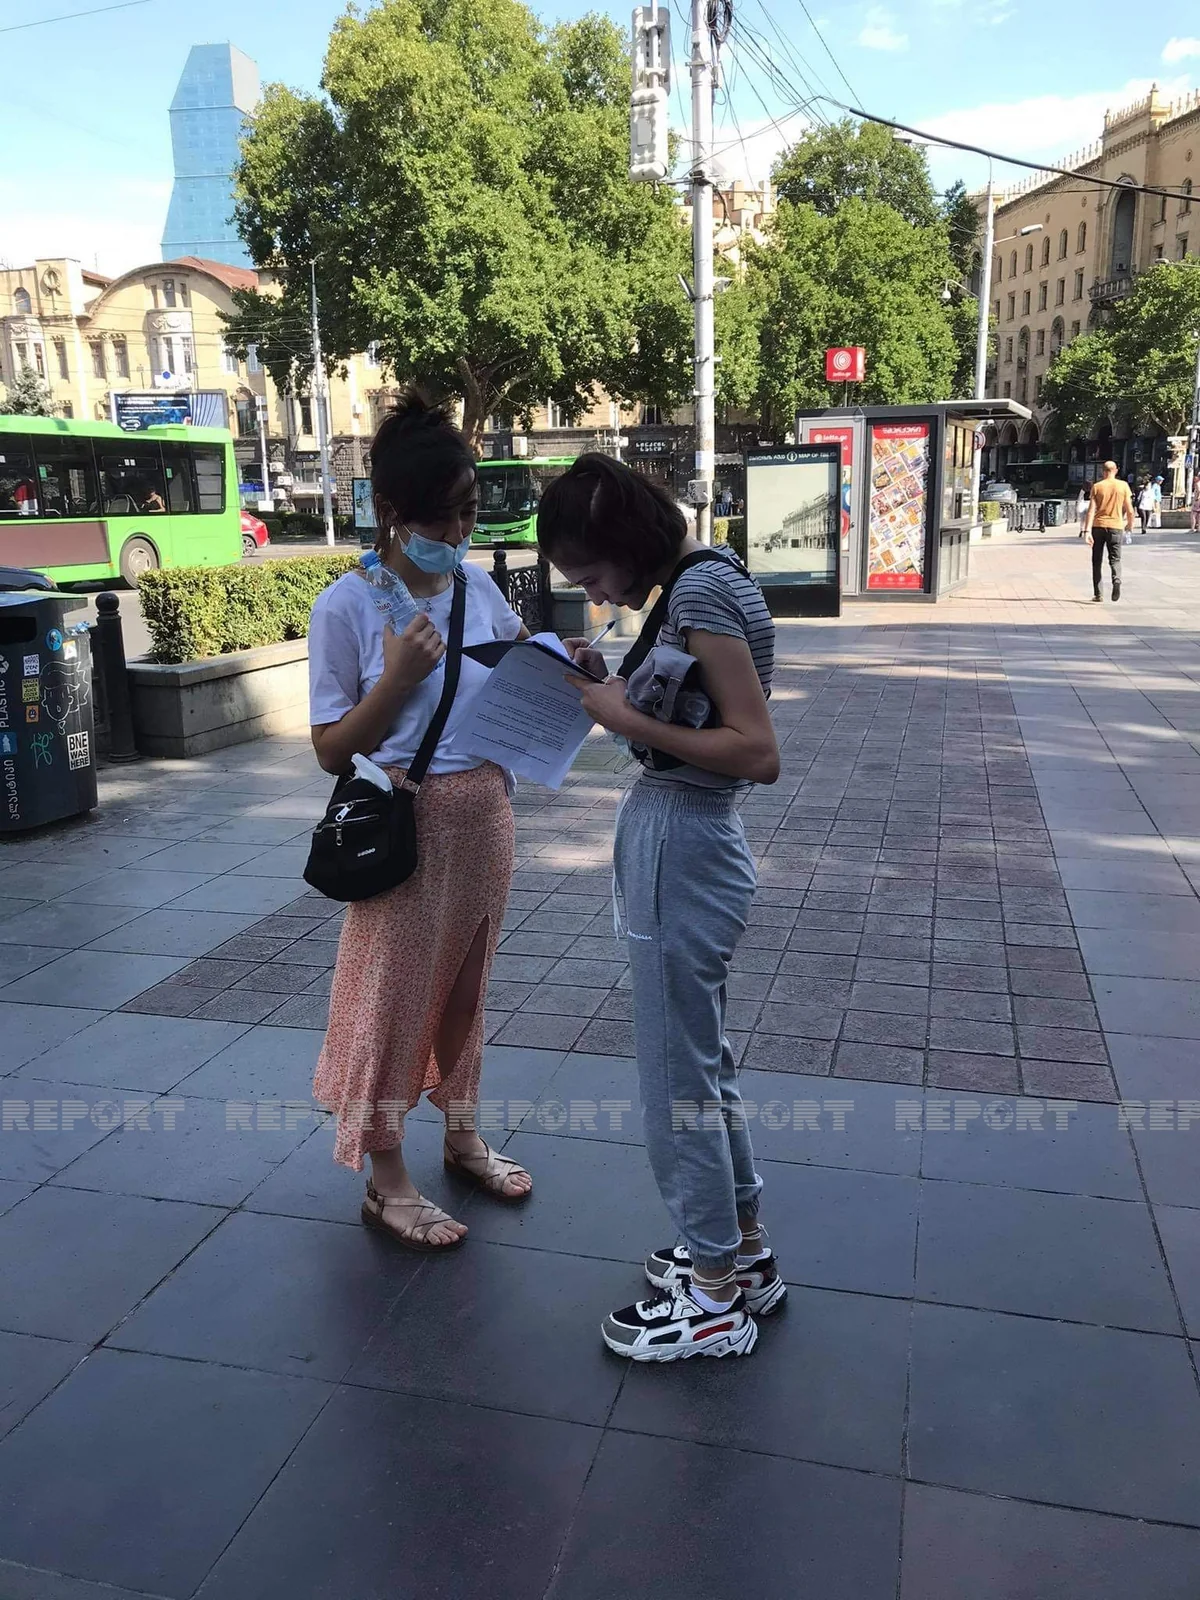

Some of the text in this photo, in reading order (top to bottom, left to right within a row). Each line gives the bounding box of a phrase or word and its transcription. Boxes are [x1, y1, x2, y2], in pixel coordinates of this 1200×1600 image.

[69, 733, 88, 751] BNE
[70, 748, 88, 760] WAS
[70, 756, 89, 769] HERE
[3, 759, 20, 820] პლასტიკი
